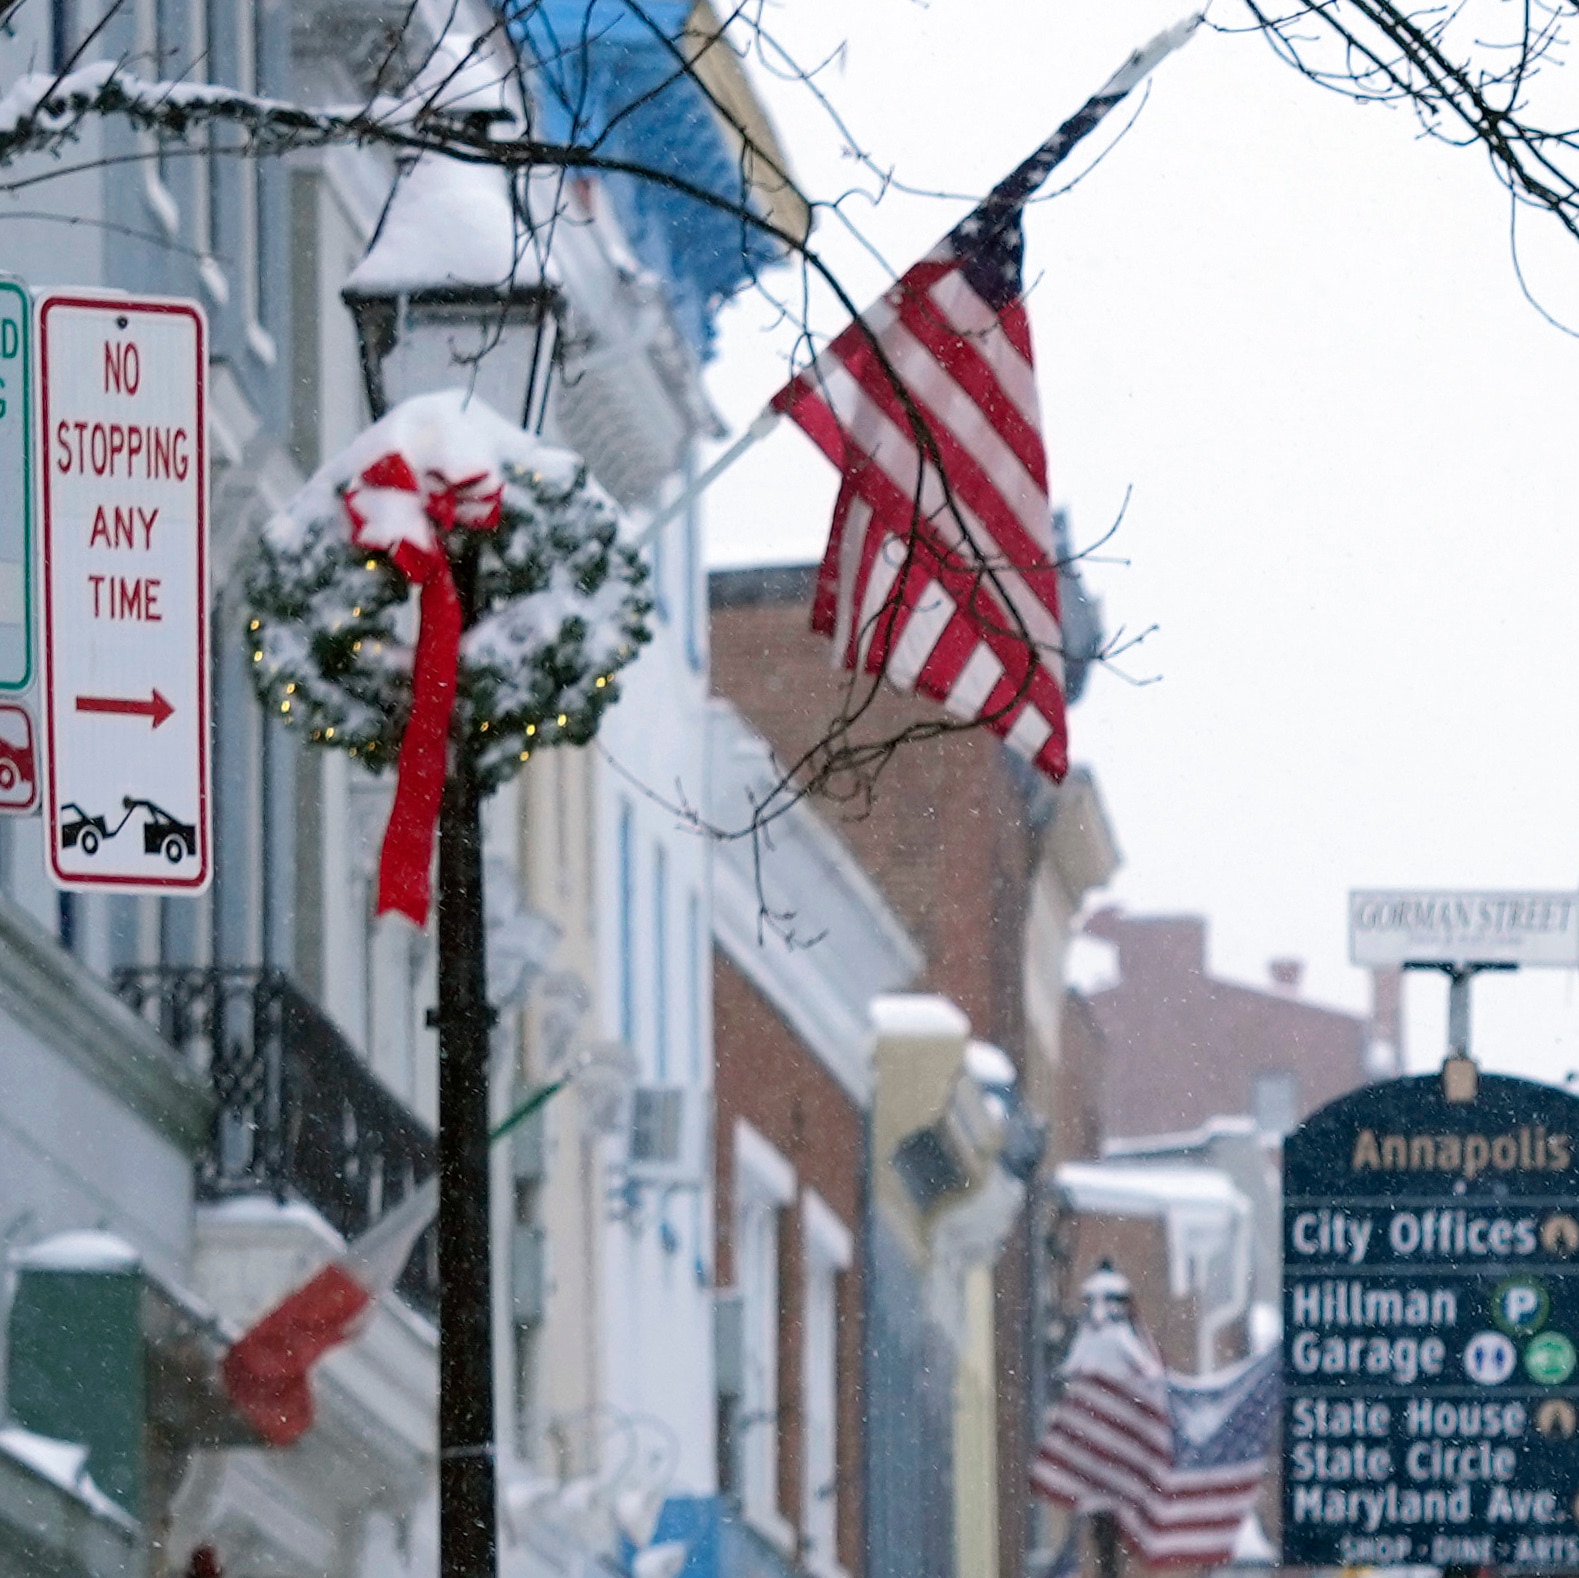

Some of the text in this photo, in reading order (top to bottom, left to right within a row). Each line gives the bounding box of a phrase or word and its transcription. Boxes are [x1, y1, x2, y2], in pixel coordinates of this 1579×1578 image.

[104, 340, 140, 395] NO
[57, 419, 189, 480] STOPPING
[89, 505, 159, 550] ANY
[88, 574, 162, 621] TIME
[1355, 898, 1572, 932] GORMAN STREET
[1352, 1126, 1572, 1180] Annapolis
[1292, 1208, 1538, 1264] City Offices
[1293, 1279, 1457, 1327] Hillman
[1292, 1330, 1446, 1384] Garage
[1293, 1398, 1527, 1438] State House
[1293, 1440, 1517, 1482] State Circle
[1293, 1484, 1568, 1533] Maryland Ave.
[1341, 1535, 1412, 1563] SHOP
[1431, 1535, 1495, 1563] DINE
